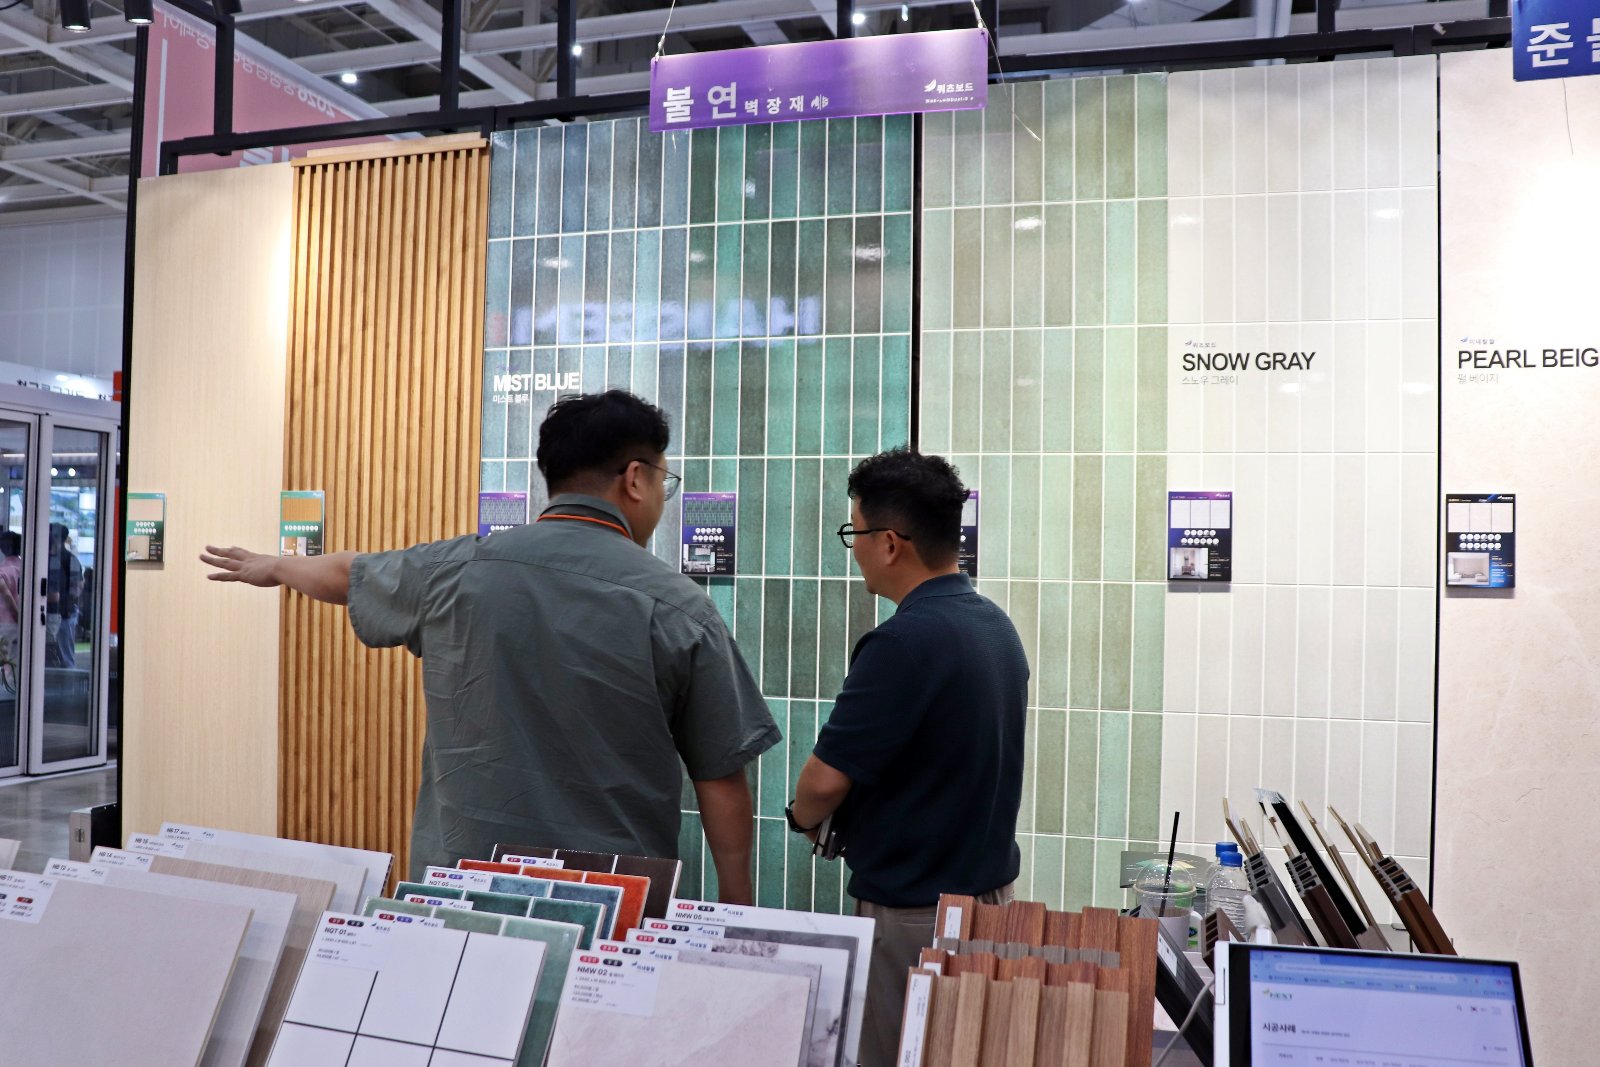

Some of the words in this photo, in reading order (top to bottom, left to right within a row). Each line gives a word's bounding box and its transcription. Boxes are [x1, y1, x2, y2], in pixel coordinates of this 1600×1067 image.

[1182, 352, 1250, 371] SNOW
[1255, 352, 1316, 370] GRAY
[1458, 350, 1537, 369] PEARL
[1542, 348, 1599, 367] BEIG
[493, 374, 532, 391] MIST
[535, 372, 579, 390] BLUE
[1182, 376, 1208, 385] 스노우
